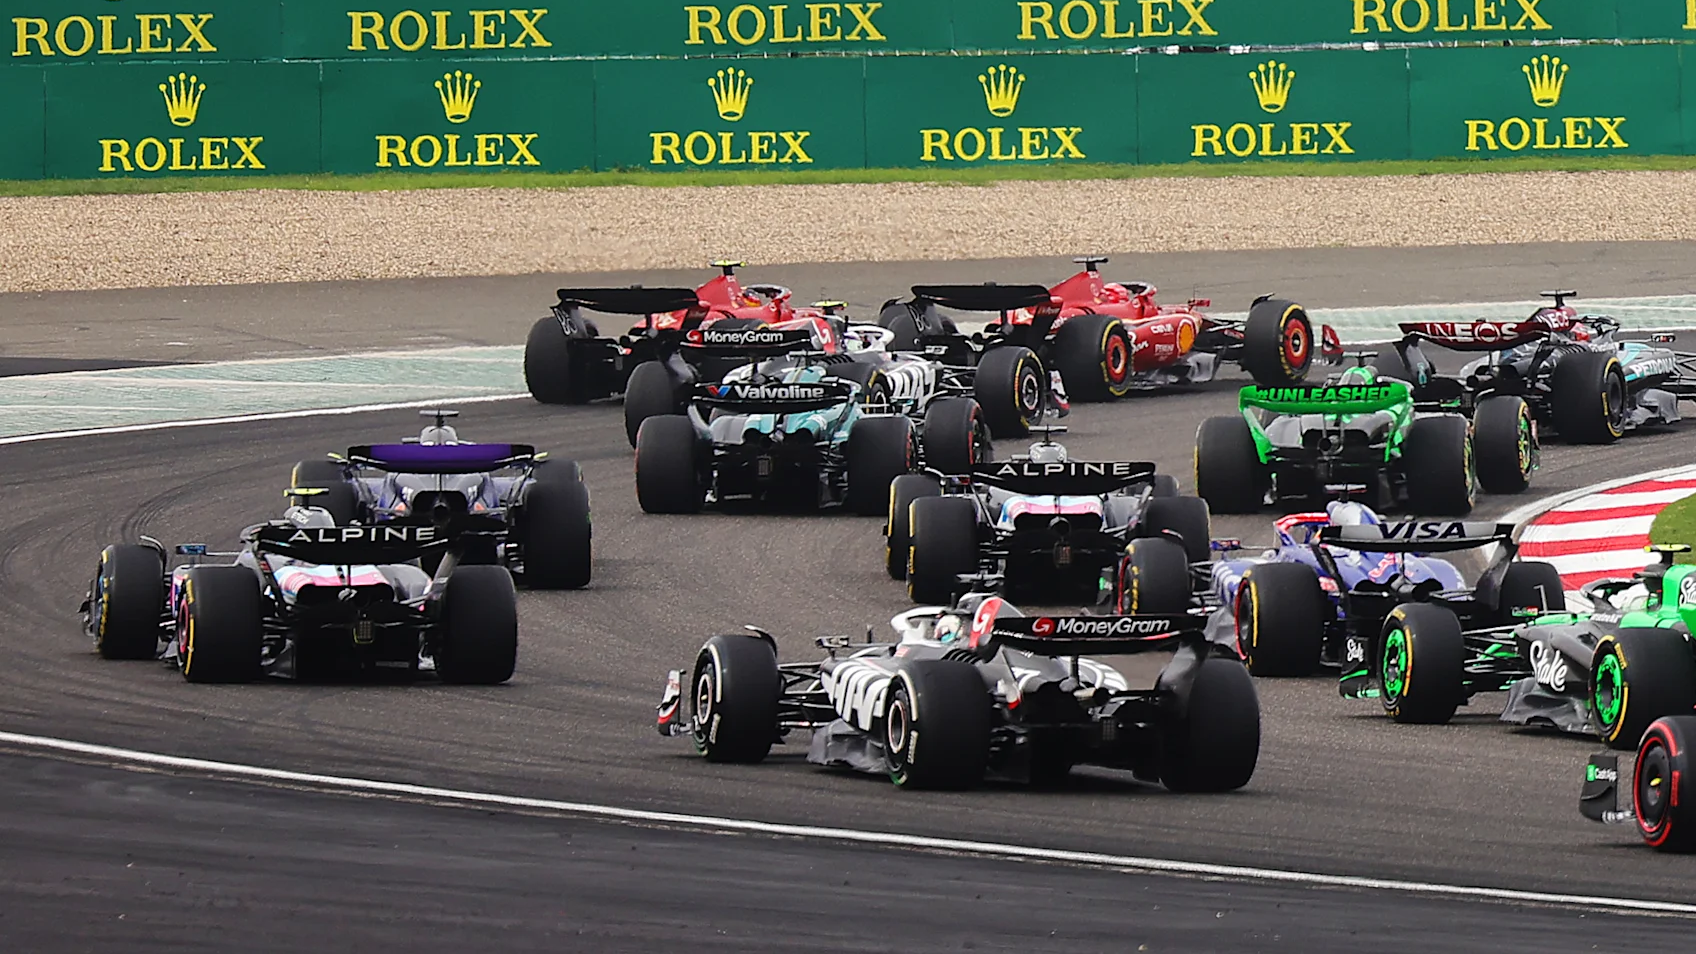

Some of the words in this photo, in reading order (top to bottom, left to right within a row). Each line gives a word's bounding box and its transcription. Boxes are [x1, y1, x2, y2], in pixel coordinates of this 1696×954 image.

[14, 15, 217, 56] ROLEX
[349, 9, 552, 51] ROLEX
[685, 3, 886, 45] ROLEX
[377, 134, 540, 167] ROLEX
[651, 131, 813, 165] ROLEX
[922, 127, 1085, 161] ROLEX
[1192, 123, 1354, 156] ROLEX
[1466, 117, 1628, 151] ROLEX
[100, 137, 265, 172] ROLEX
[703, 331, 784, 344] MoneyGram
[1425, 323, 1519, 343] INEOS
[735, 384, 825, 399] Valvoline
[997, 463, 1131, 476] ALPINE
[288, 527, 435, 543] ALPINE
[1379, 522, 1467, 539] VISA
[1056, 618, 1170, 637] MoneyGram
[1529, 640, 1568, 692] Stake
